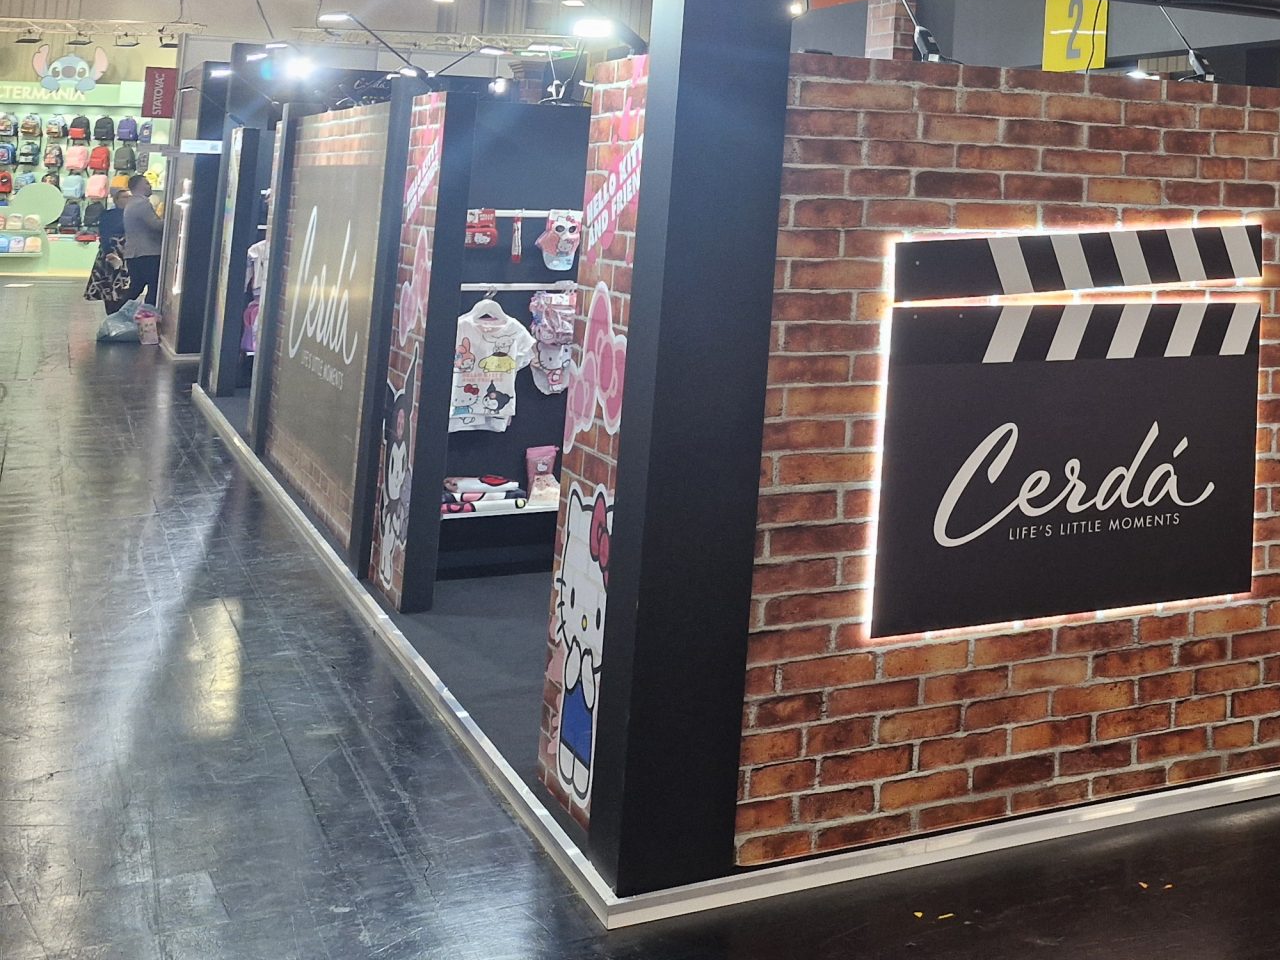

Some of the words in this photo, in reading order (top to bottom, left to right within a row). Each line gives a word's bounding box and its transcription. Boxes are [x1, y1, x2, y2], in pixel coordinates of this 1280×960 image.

[586, 172, 617, 228] HELLO
[588, 208, 609, 252] AND
[289, 205, 358, 365] Cerdá
[933, 421, 1215, 547] Cerdá
[1009, 524, 1052, 541] LIFE'S
[1060, 520, 1101, 536] LITTLE
[1108, 512, 1180, 531] MOMENTS
